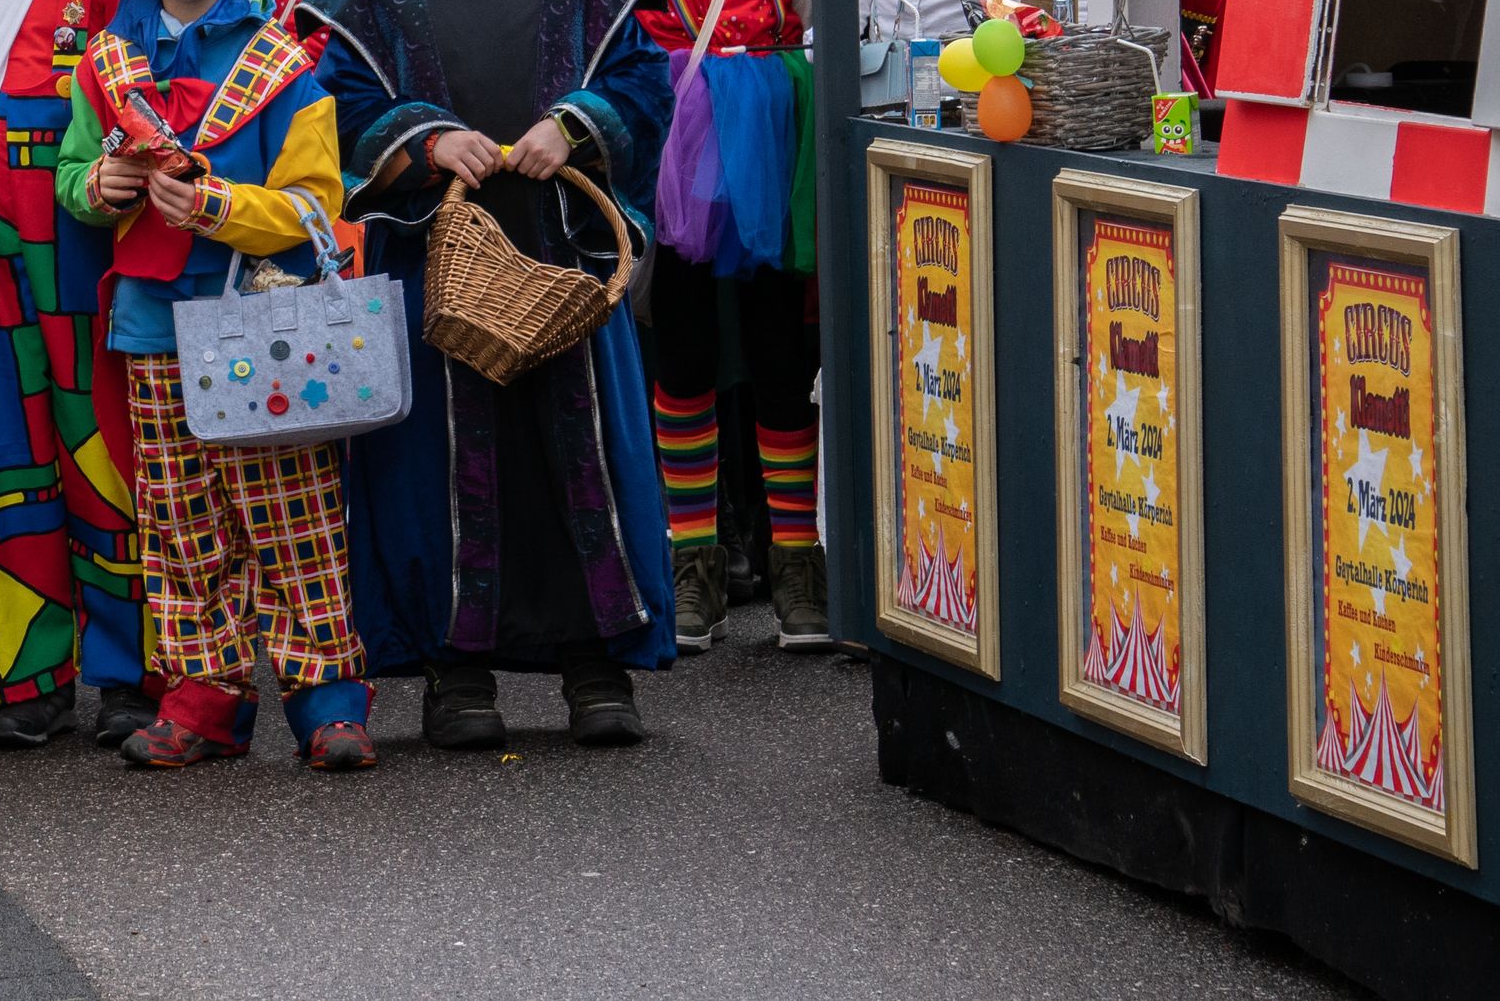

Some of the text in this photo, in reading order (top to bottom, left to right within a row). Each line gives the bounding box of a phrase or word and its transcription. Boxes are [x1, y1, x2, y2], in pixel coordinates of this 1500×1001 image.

[913, 216, 960, 277] CIRCUS
[1106, 255, 1162, 322] CIRCUS
[1344, 302, 1413, 378] CIRCUS
[923, 363, 942, 397] März
[943, 369, 962, 403] 2024
[1107, 414, 1163, 461] 2. März 2024
[1138, 496, 1173, 526] Körperich
[1347, 477, 1416, 531] 2. März 2024
[1335, 554, 1429, 604] Gaytalhalle Körperich
[1359, 609, 1371, 625] und
